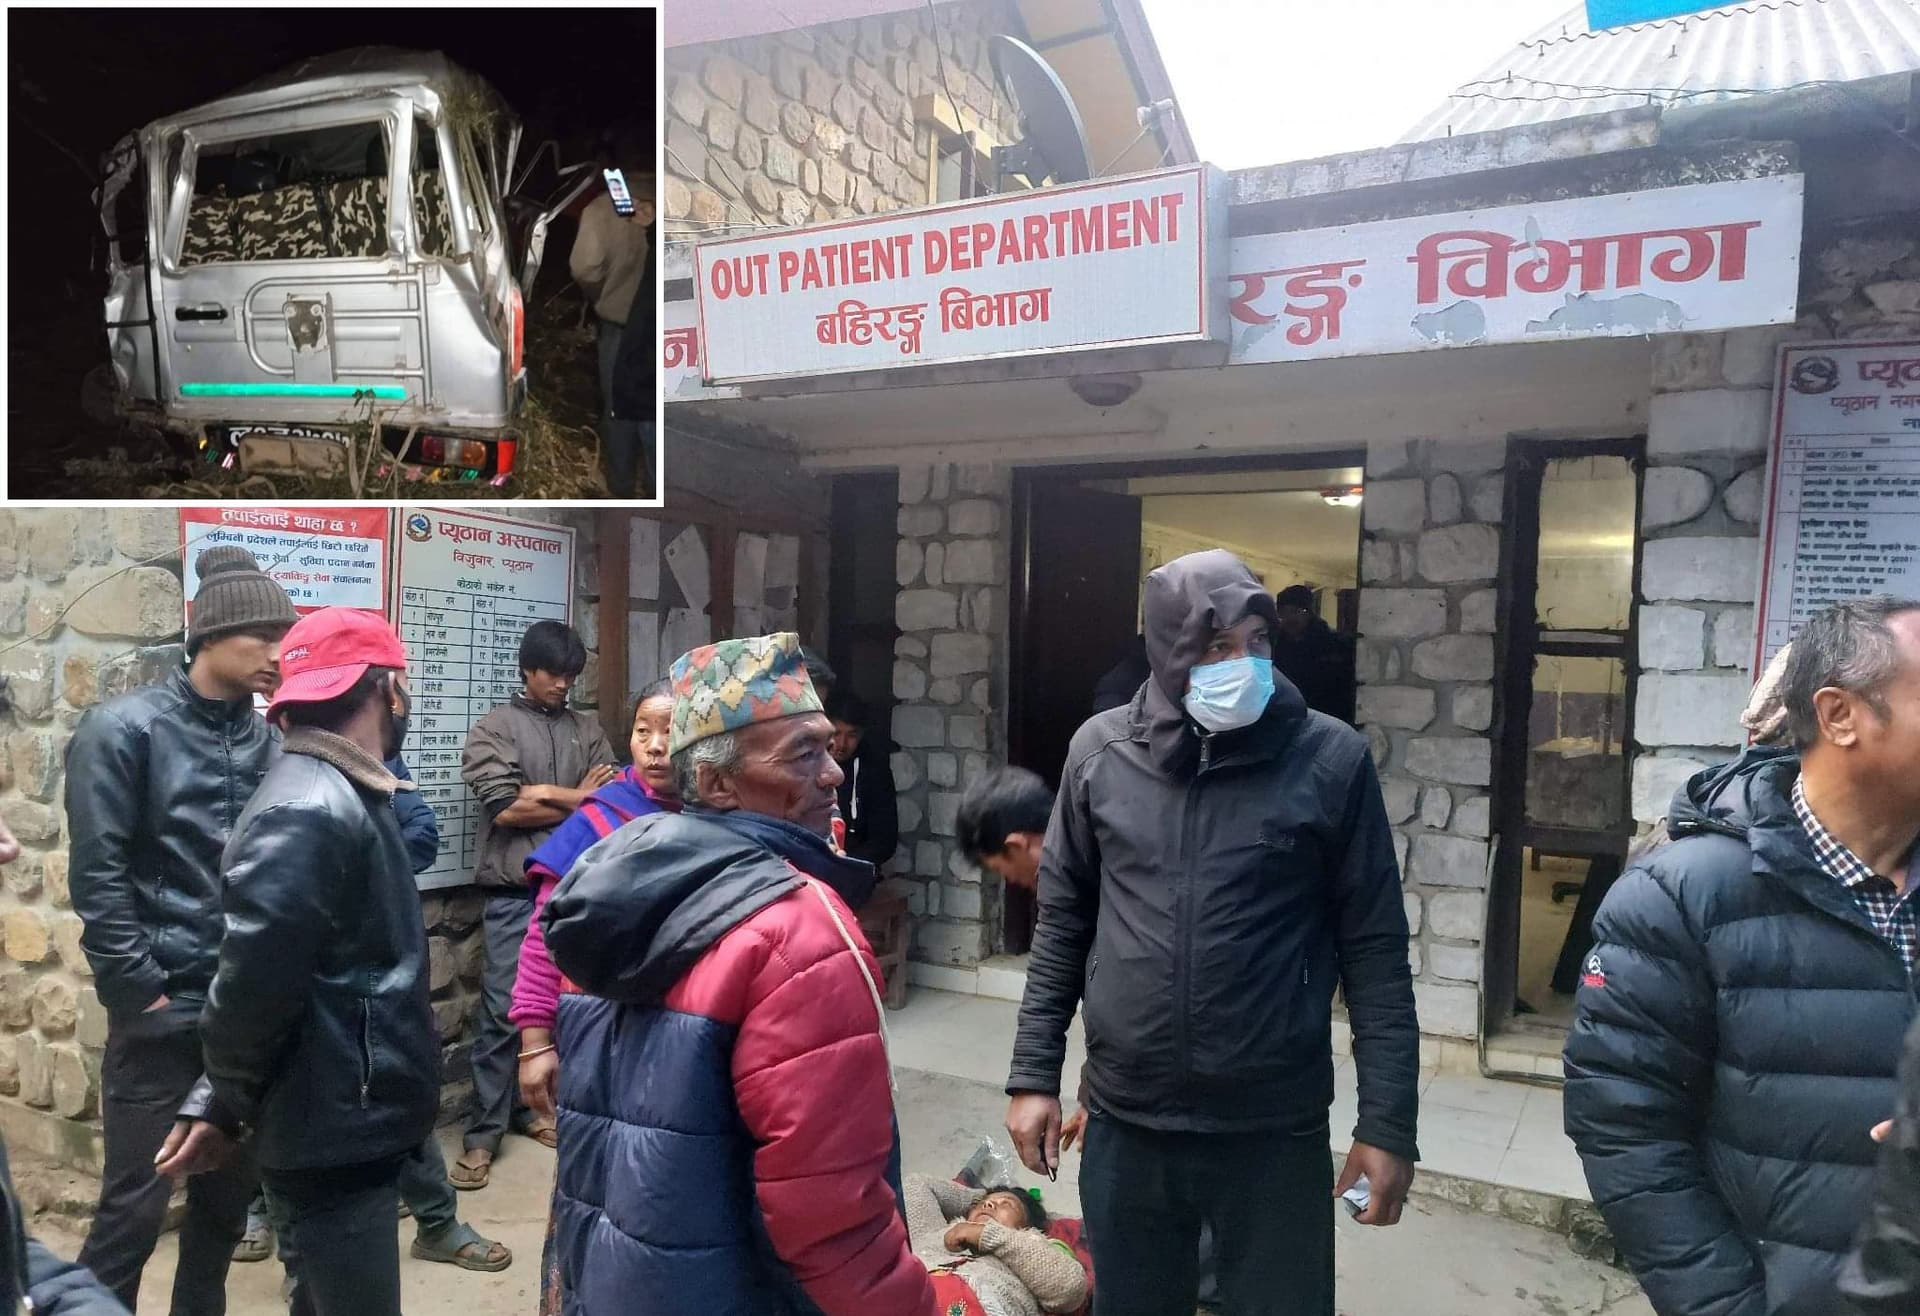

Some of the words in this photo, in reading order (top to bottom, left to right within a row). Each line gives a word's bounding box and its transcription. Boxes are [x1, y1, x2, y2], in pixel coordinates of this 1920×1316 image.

[711, 253, 770, 301] OUT
[779, 234, 914, 293] PATIENT
[924, 193, 1184, 275] DEPARTMENT
[1407, 219, 1762, 304] विभाग
[940, 287, 1052, 333] बिभाग
[294, 516, 326, 531] थाहा
[330, 519, 344, 532] छ
[350, 521, 358, 533] ?
[207, 531, 243, 542] लुम्बिनी
[247, 534, 277, 545] प्रदेशले
[321, 540, 342, 551] छिटो
[345, 542, 369, 553] छरितो
[438, 521, 492, 544] प्यूठान
[496, 531, 563, 554] अस्पताल
[272, 552, 289, 563] सेवा
[300, 555, 324, 567] सुविधा
[328, 558, 350, 568] प्रदान
[502, 558, 535, 573] प्यूठान
[314, 572, 330, 583] सेवा
